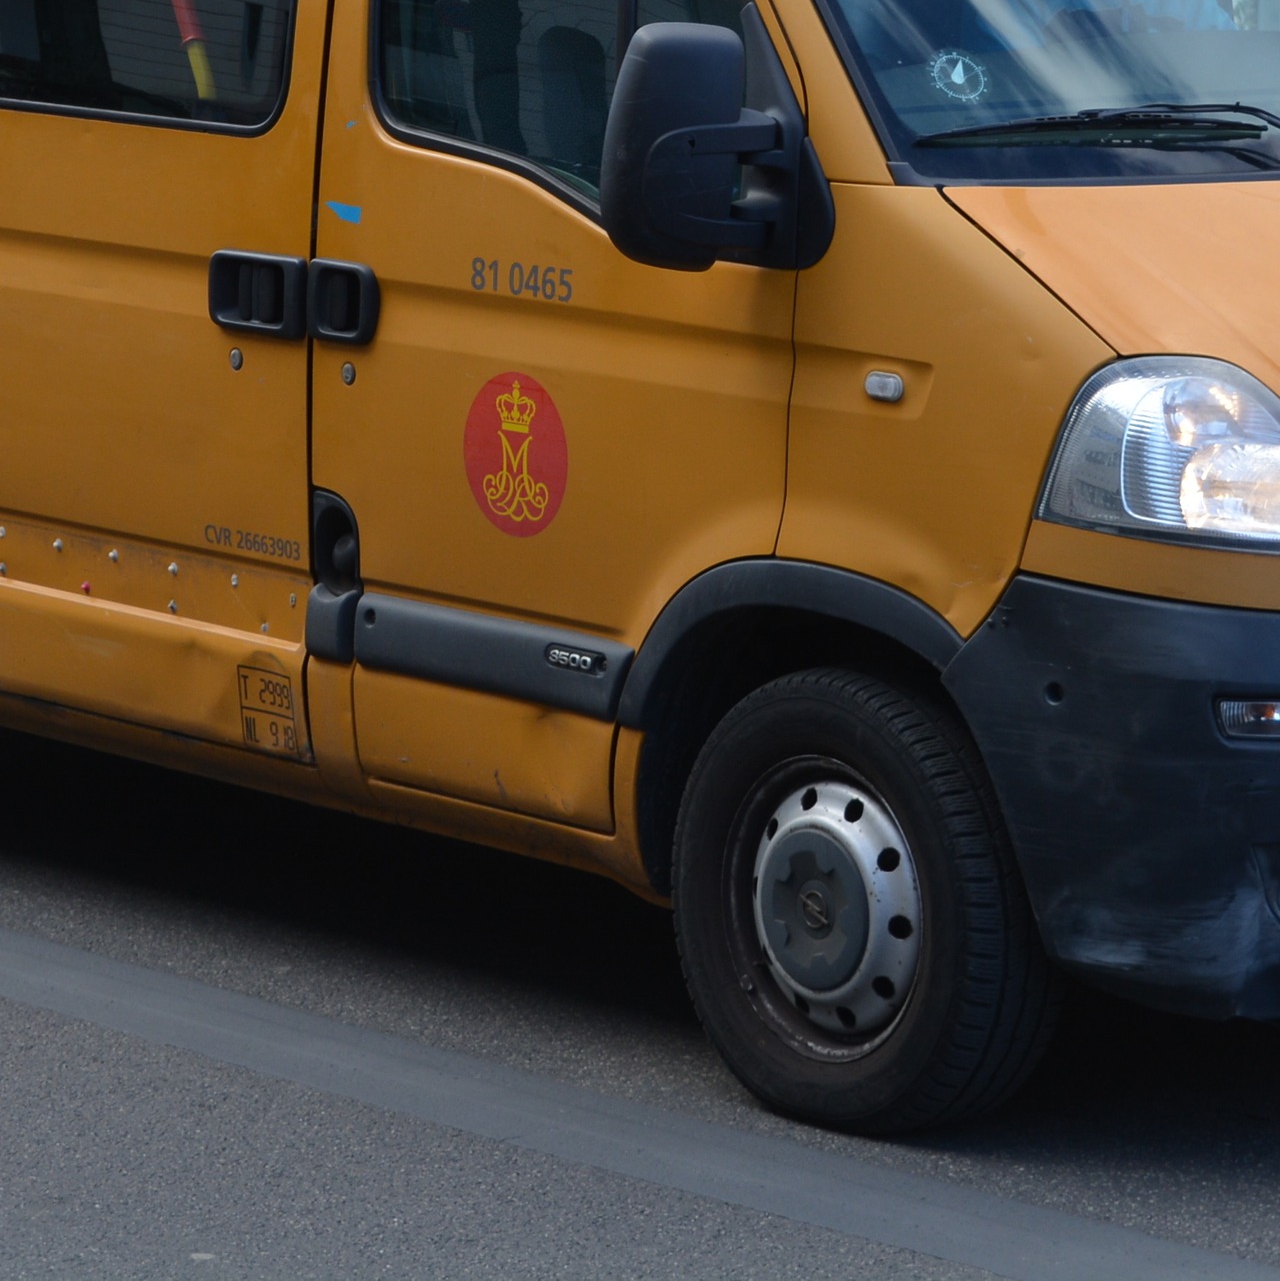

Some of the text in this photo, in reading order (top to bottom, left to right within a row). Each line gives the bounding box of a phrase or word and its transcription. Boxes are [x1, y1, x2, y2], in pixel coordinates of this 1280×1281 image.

[470, 256, 574, 304] 81 0465
[204, 523, 301, 562] CVR 26663903
[548, 648, 592, 670] 3500
[240, 674, 291, 710] T 2999
